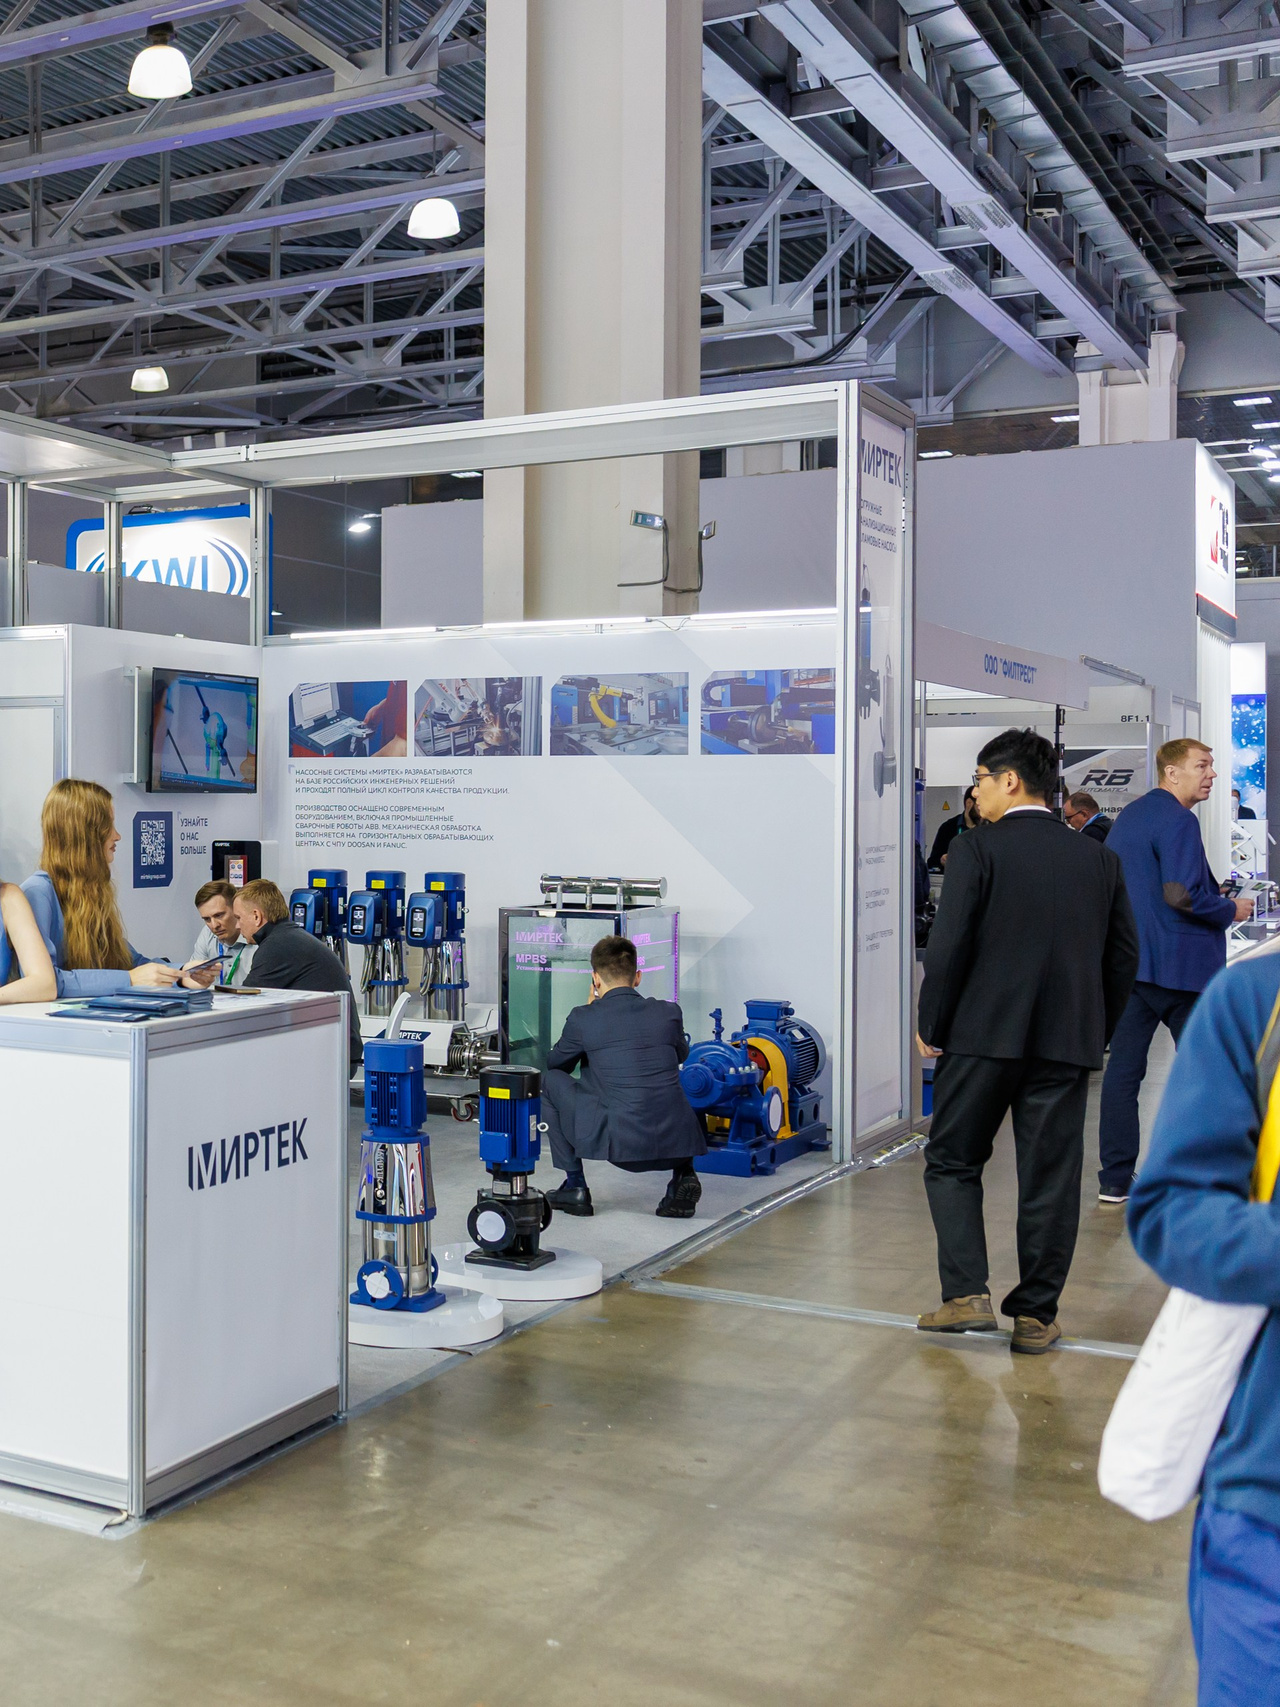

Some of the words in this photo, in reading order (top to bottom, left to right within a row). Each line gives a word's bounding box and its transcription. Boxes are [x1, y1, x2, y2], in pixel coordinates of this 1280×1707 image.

[984, 653, 998, 675] ООО
[1000, 657, 1037, 684] "ФИЛТРЕСТ"
[1121, 714, 1150, 723] 8F1.1
[404, 768, 473, 776] РАЗРАБАТЫВАЮТСЯ
[323, 776, 368, 785] РОССИЙСКИХ
[420, 776, 455, 785] РЕШЕНИЙ
[1080, 769, 1134, 786] RB
[337, 785, 367, 794] ПОЛНЫЙ
[463, 787, 510, 795] ПРОДУКЦИИ.
[390, 805, 445, 813] СОВРЕМЕННЫМ
[180, 816, 208, 828] УЗНАЙТЕ
[180, 832, 186, 841] О
[187, 832, 199, 841] НАС
[180, 846, 207, 855] БОЛЬШЕ
[516, 931, 563, 943] МИРТЕК
[515, 954, 547, 964] MPBS
[187, 1117, 309, 1192] МИРТЕК
